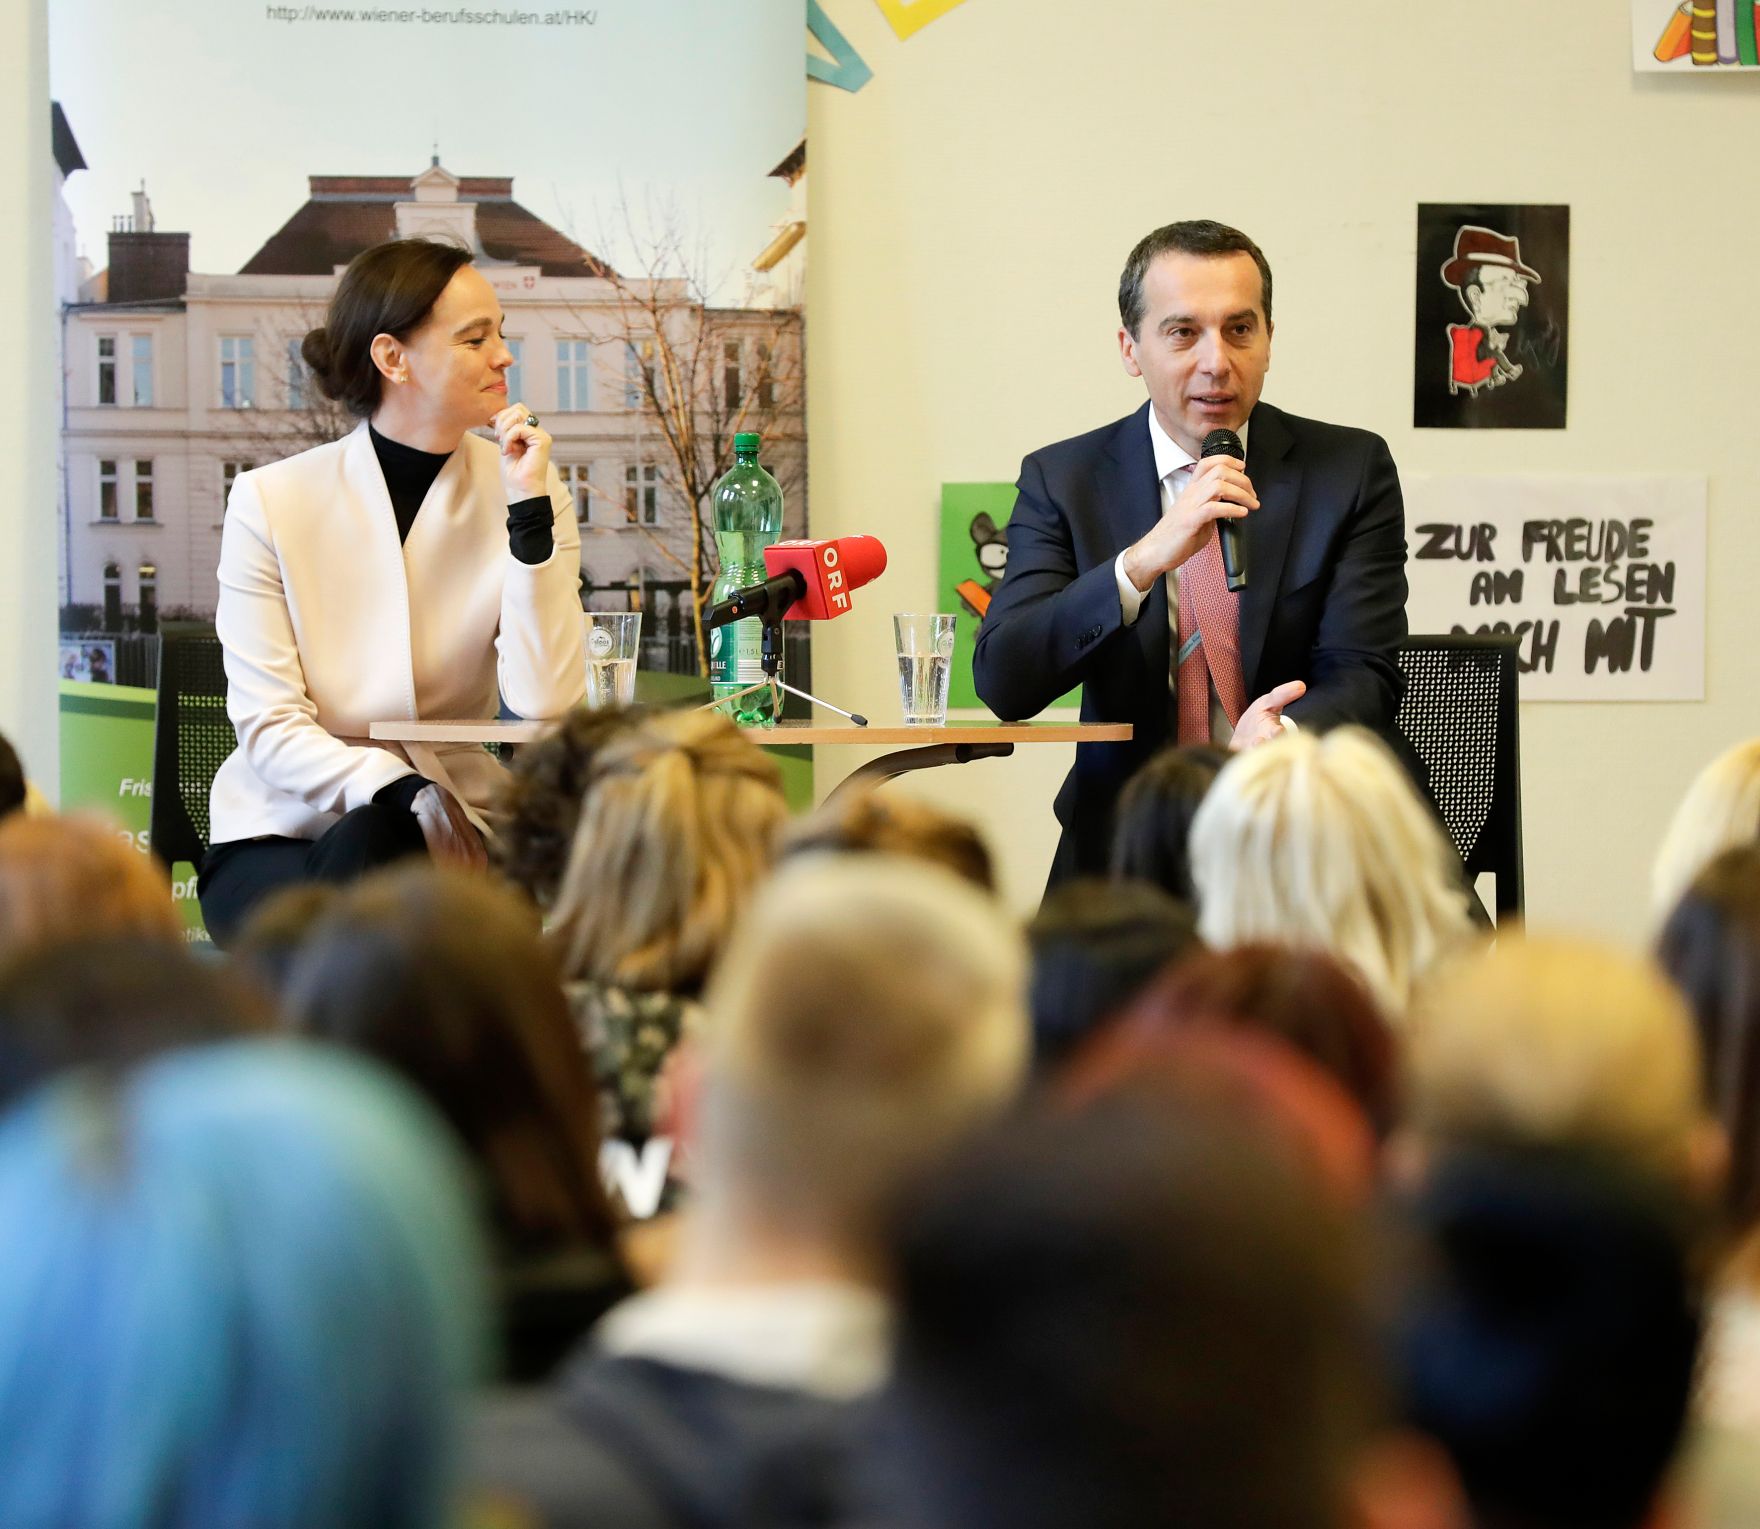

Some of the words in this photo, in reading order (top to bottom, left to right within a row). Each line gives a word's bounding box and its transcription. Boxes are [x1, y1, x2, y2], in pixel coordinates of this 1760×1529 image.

[266, 5, 598, 26] http://www.wiener-berufsschulen.at/HK/
[1415, 523, 1497, 562] ZUR
[1522, 517, 1654, 563] FREUDE
[823, 547, 847, 609] ORF
[1469, 568, 1524, 606] AM
[1554, 561, 1675, 605] LESEN
[1450, 619, 1560, 674] CH
[1584, 607, 1677, 675] MIT
[119, 778, 153, 797] Fris
